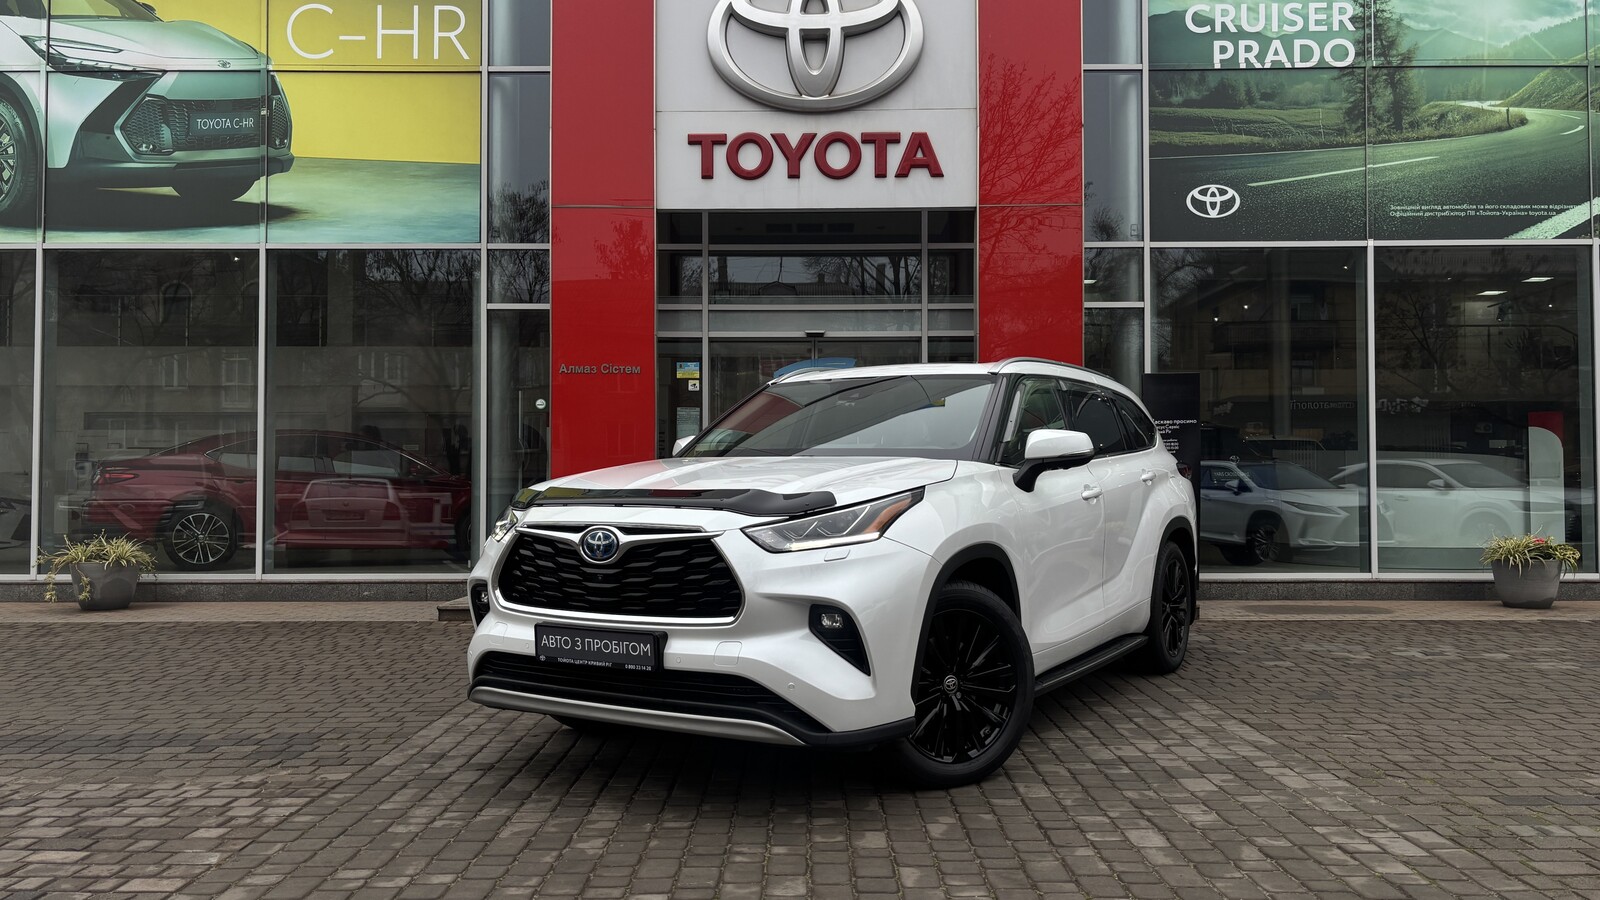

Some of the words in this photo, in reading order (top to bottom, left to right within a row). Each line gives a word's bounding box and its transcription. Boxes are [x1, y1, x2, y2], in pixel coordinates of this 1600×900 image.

[286, 3, 470, 60] C-HR
[1184, 2, 1356, 34] CRUISER
[1213, 38, 1356, 69] PRADO
[196, 118, 232, 130] TOYOTA
[233, 117, 254, 129] C-HR
[687, 131, 945, 181] TOYOTA
[559, 363, 597, 374] Алмаз
[600, 363, 641, 374] Сістем
[541, 635, 572, 650] АВТО
[584, 638, 651, 657] ПРОБІГОМ
